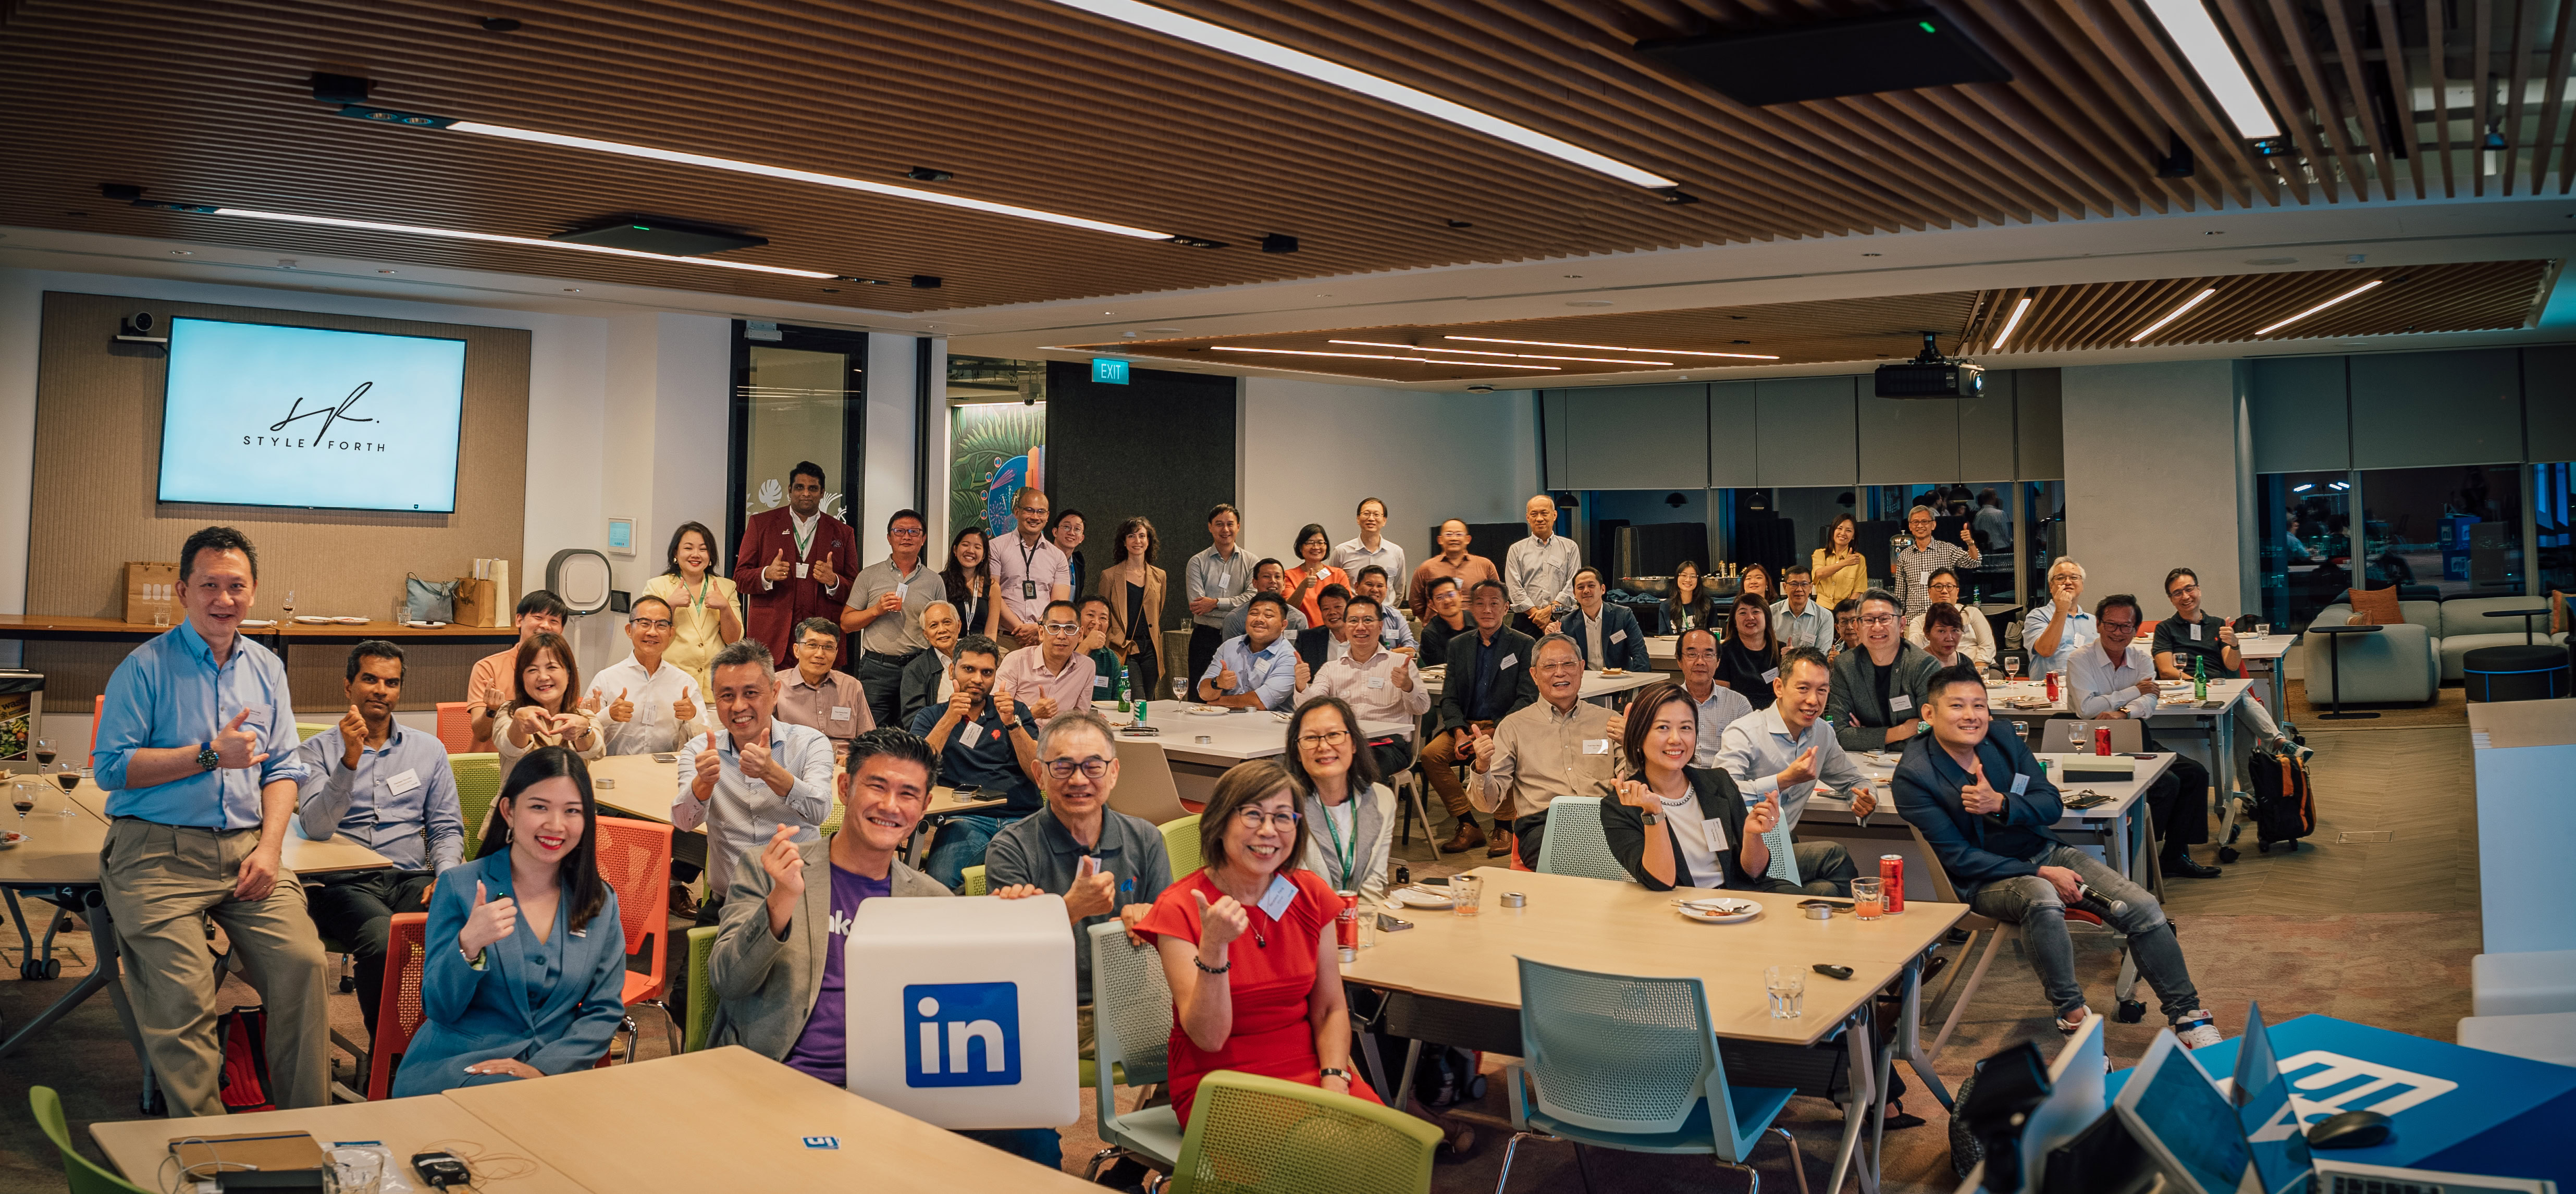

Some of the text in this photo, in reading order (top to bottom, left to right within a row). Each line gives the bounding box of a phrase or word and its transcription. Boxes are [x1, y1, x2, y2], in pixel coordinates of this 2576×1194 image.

[1101, 363, 1121, 380] EXIT
[243, 436, 385, 452] STYLE FORTH
[917, 996, 1005, 1074] in
[807, 1137, 834, 1147] in
